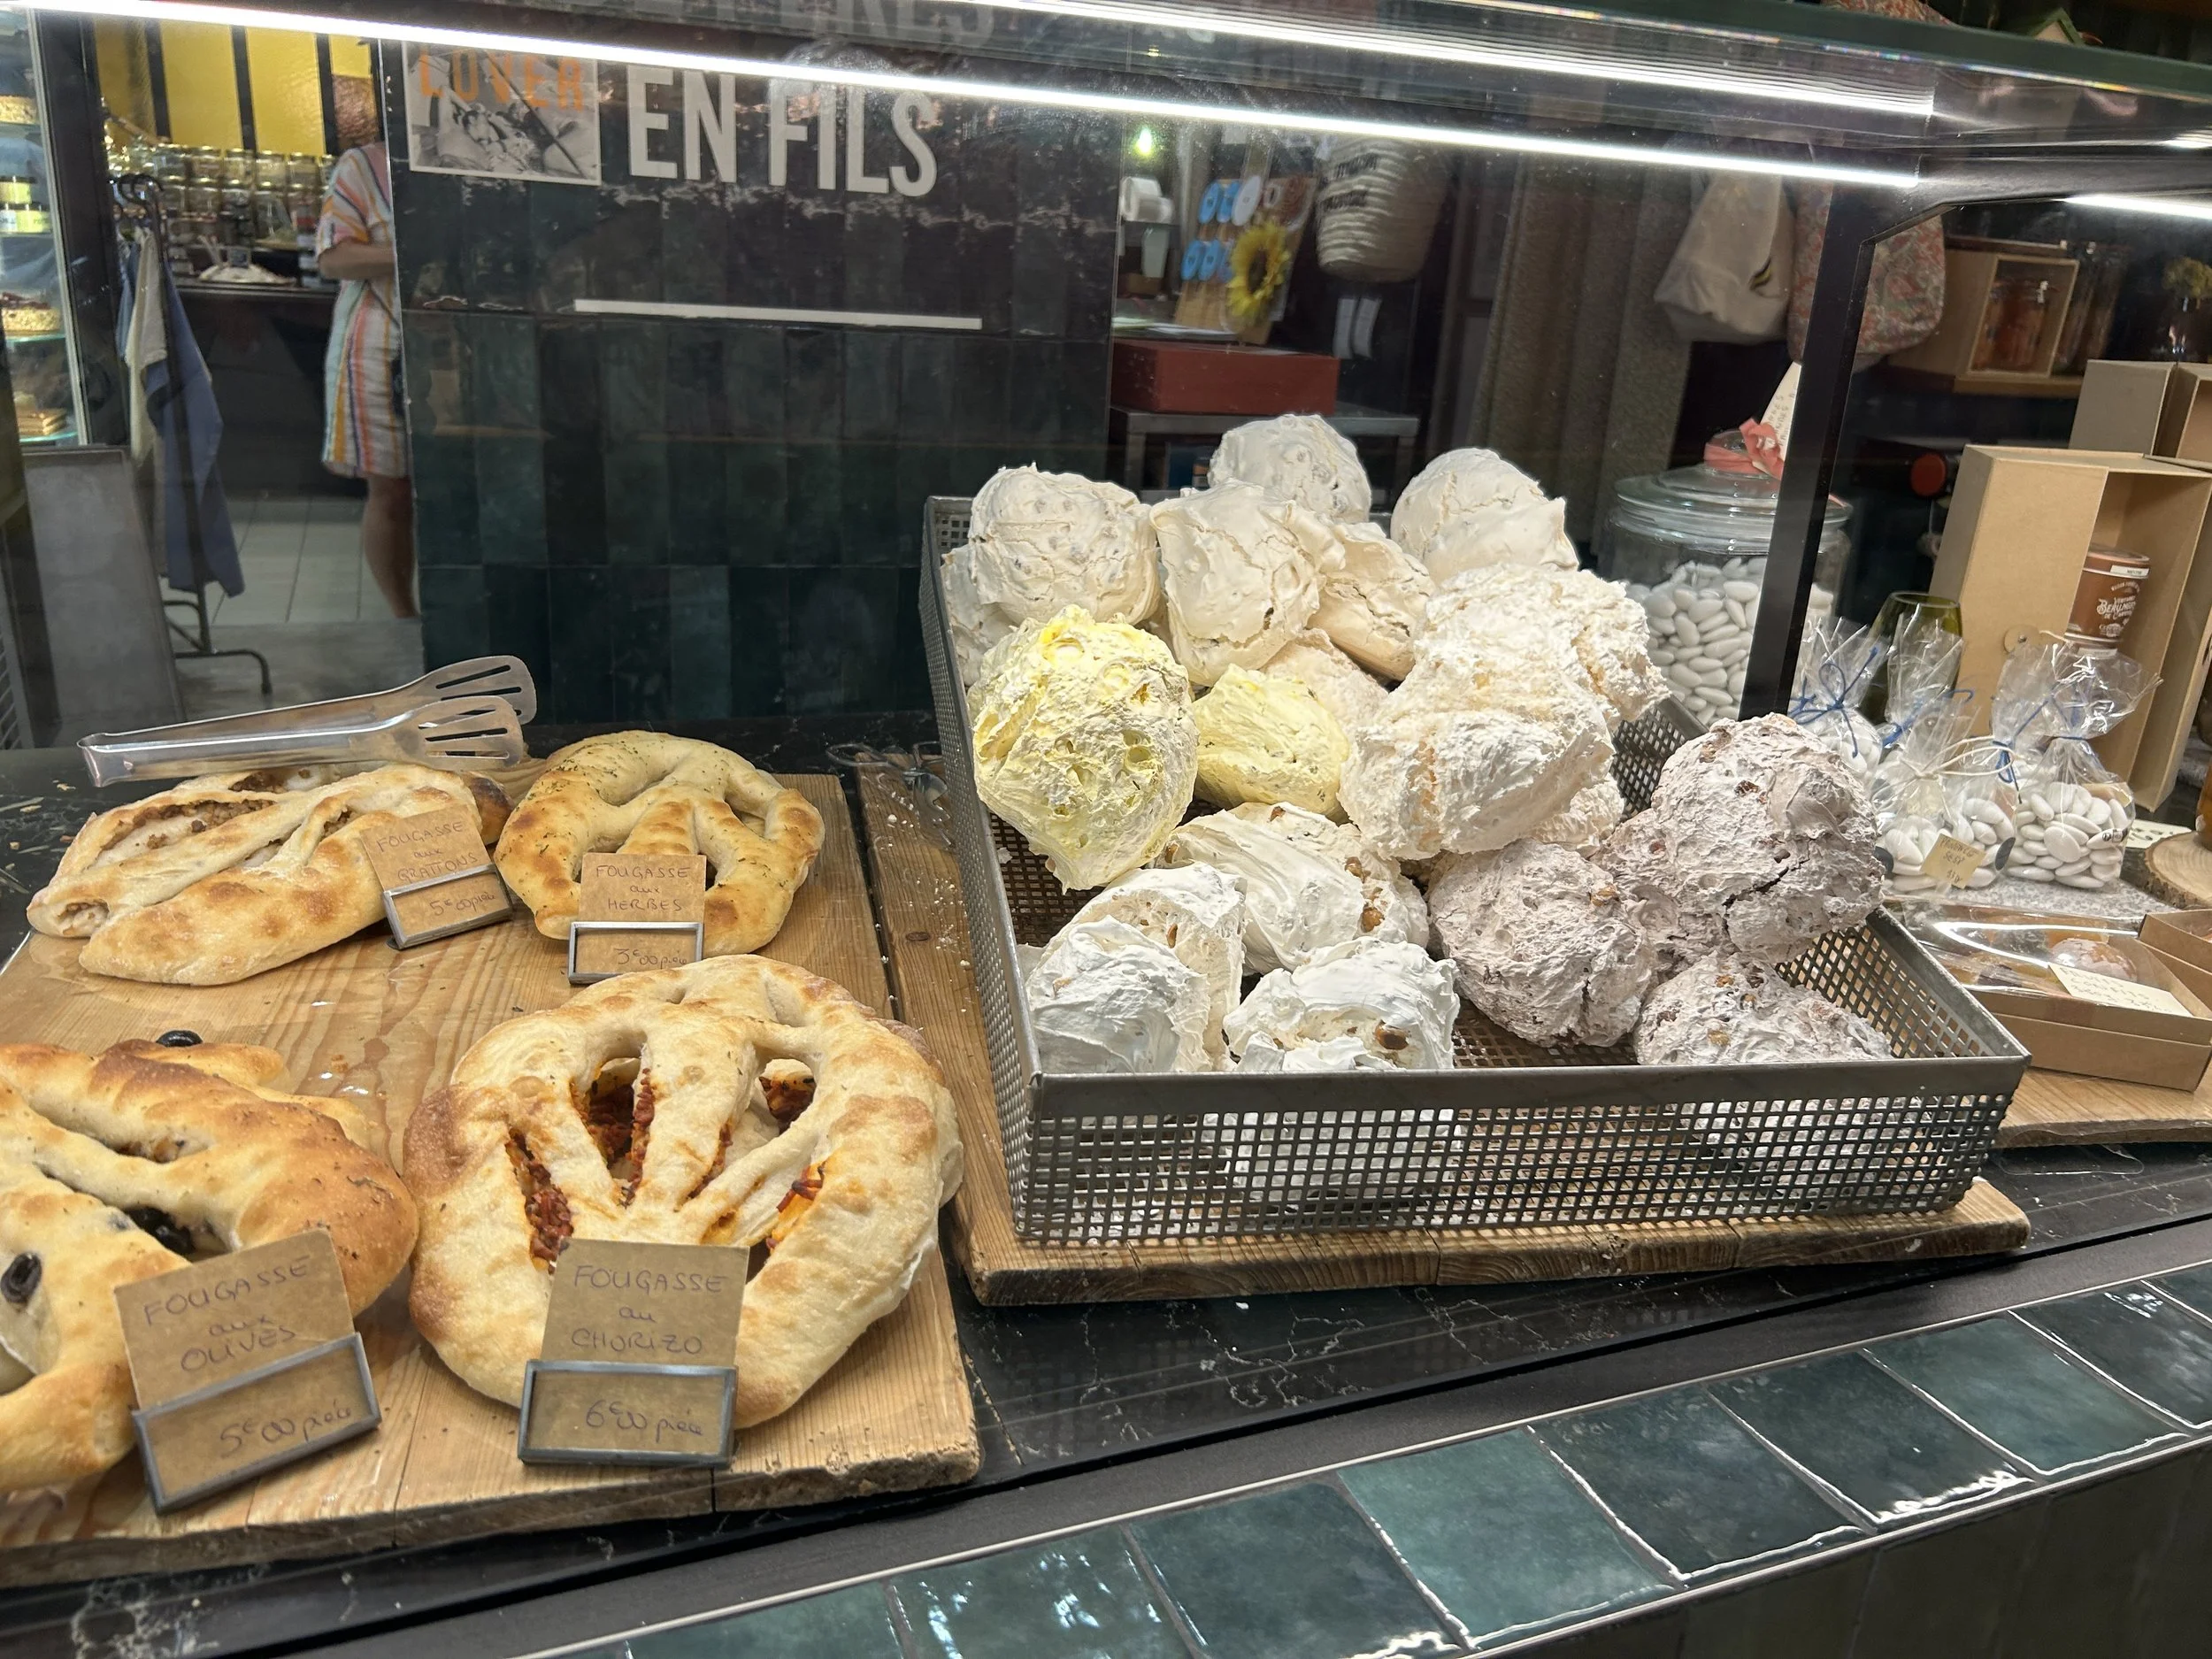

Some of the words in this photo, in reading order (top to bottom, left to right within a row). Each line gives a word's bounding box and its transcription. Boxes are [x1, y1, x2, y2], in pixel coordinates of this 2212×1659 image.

[626, 65, 737, 183] EN
[767, 78, 938, 197] FILS
[376, 821, 465, 853] FOUGASSE
[397, 852, 479, 884] GRATTONS
[595, 864, 691, 879] FOUGASSE
[608, 898, 683, 911] HERBES
[142, 1255, 311, 1326] FOUGASSE
[573, 1264, 730, 1294] FOUGASSE
[208, 1314, 274, 1338] aux
[618, 1305, 657, 1324] au
